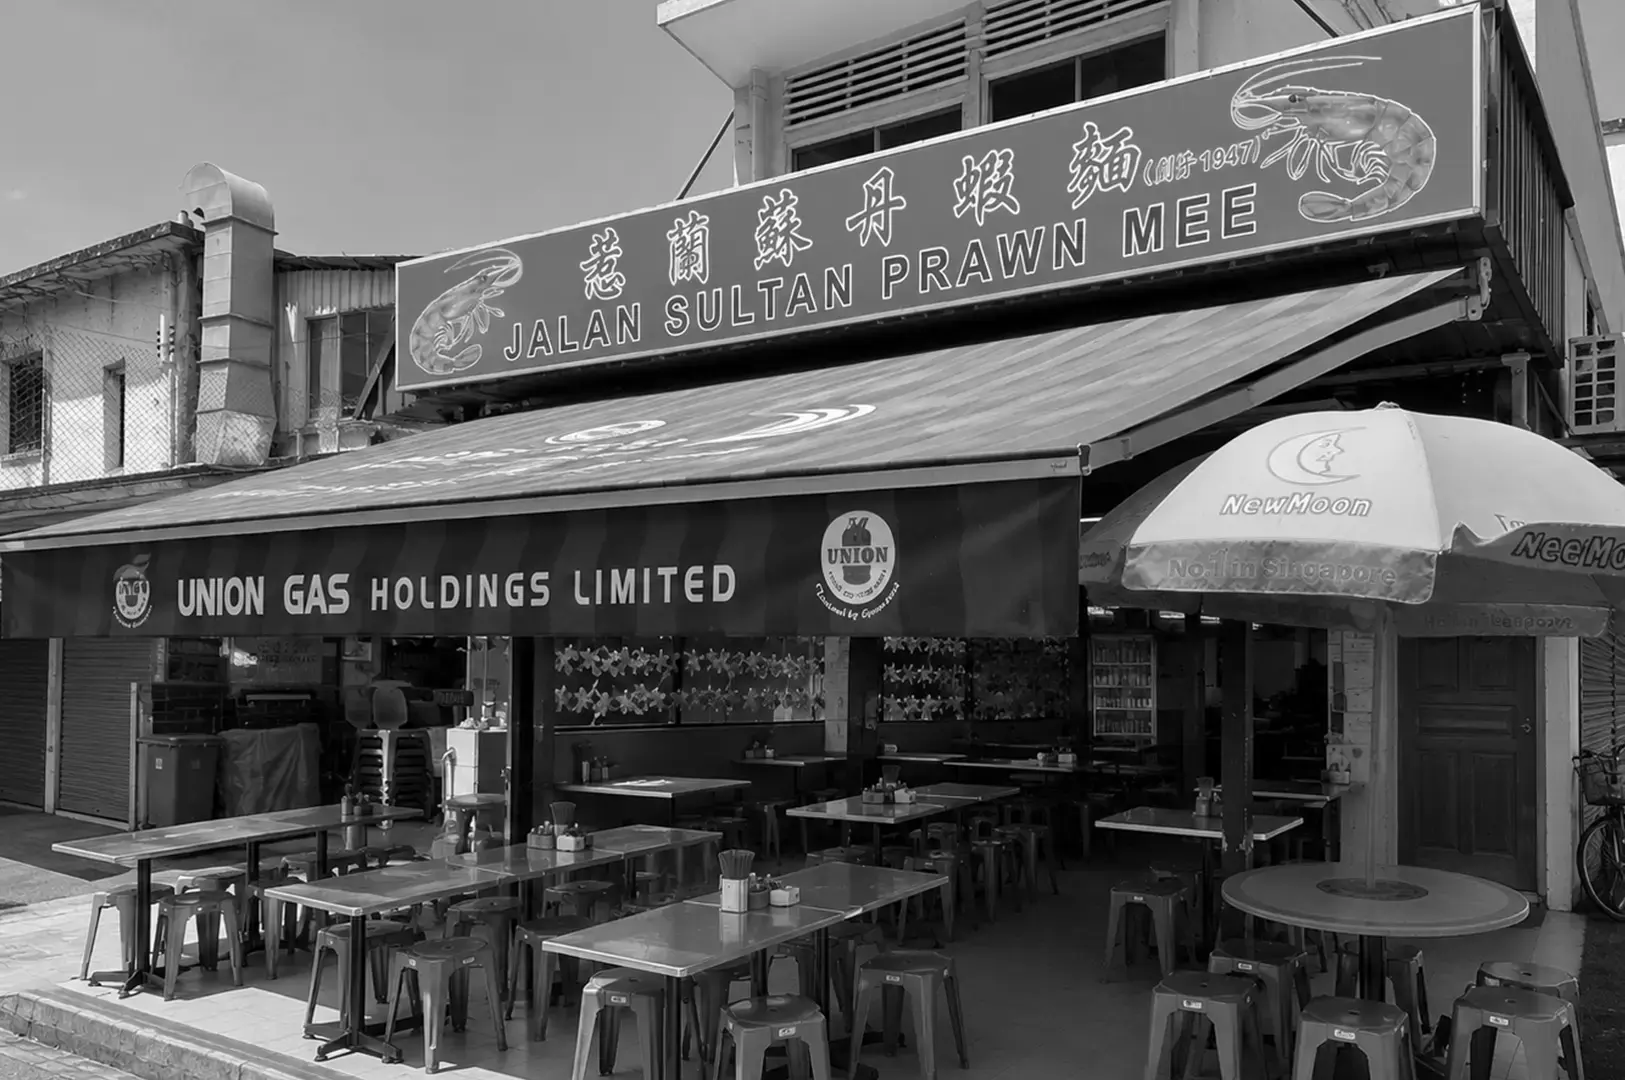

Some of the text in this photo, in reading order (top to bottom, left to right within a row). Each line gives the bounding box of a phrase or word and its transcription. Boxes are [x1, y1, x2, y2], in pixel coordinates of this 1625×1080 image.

[503, 183, 1257, 361] JALAN SULTAN PRAWN MEE
[1219, 492, 1372, 516] NewMoon
[827, 546, 888, 565] UNION
[1261, 555, 1397, 586] Sigapore
[177, 564, 736, 616] UNION GAS HOLDINGS LIMITED
